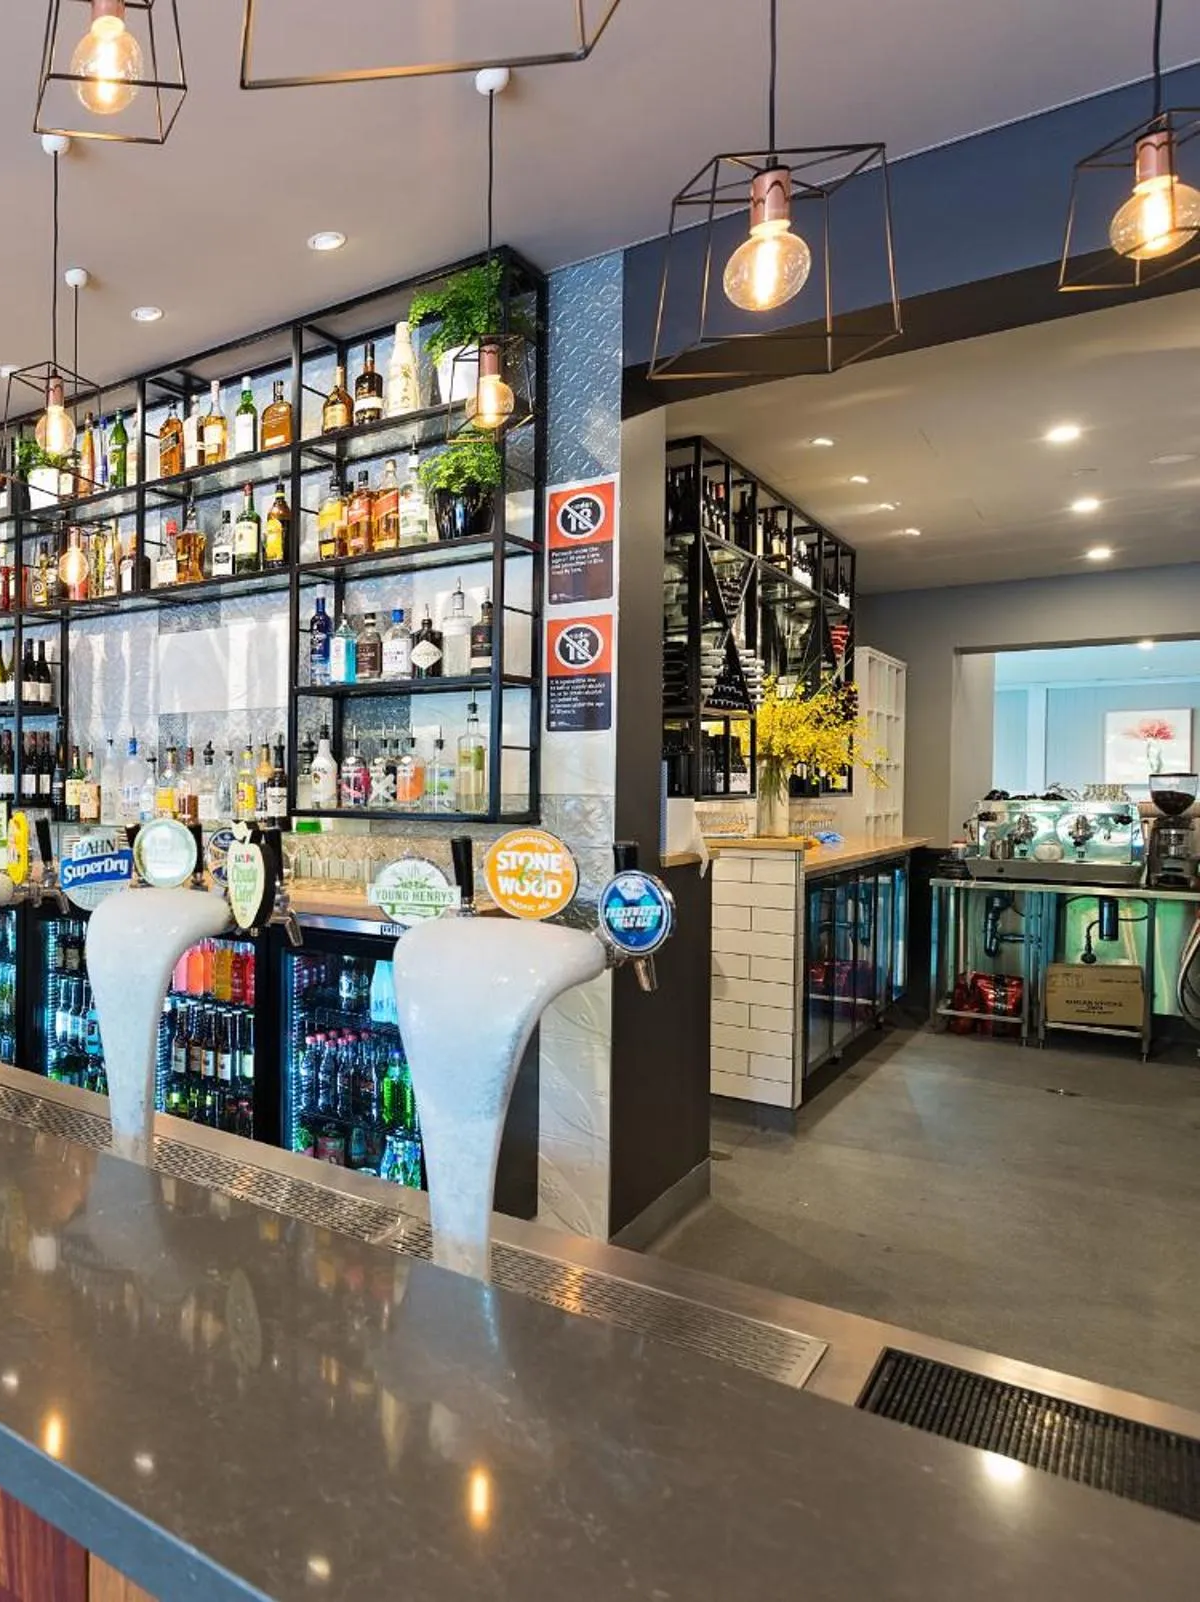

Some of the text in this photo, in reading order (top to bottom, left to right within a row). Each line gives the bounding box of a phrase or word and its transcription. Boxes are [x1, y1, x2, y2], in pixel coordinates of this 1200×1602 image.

[567, 508, 593, 532] 18
[565, 638, 590, 660] 18
[63, 857, 129, 884] SuperDry
[496, 850, 563, 875] STONE
[376, 888, 409, 901] YOUNG
[498, 876, 562, 899] WOOD
